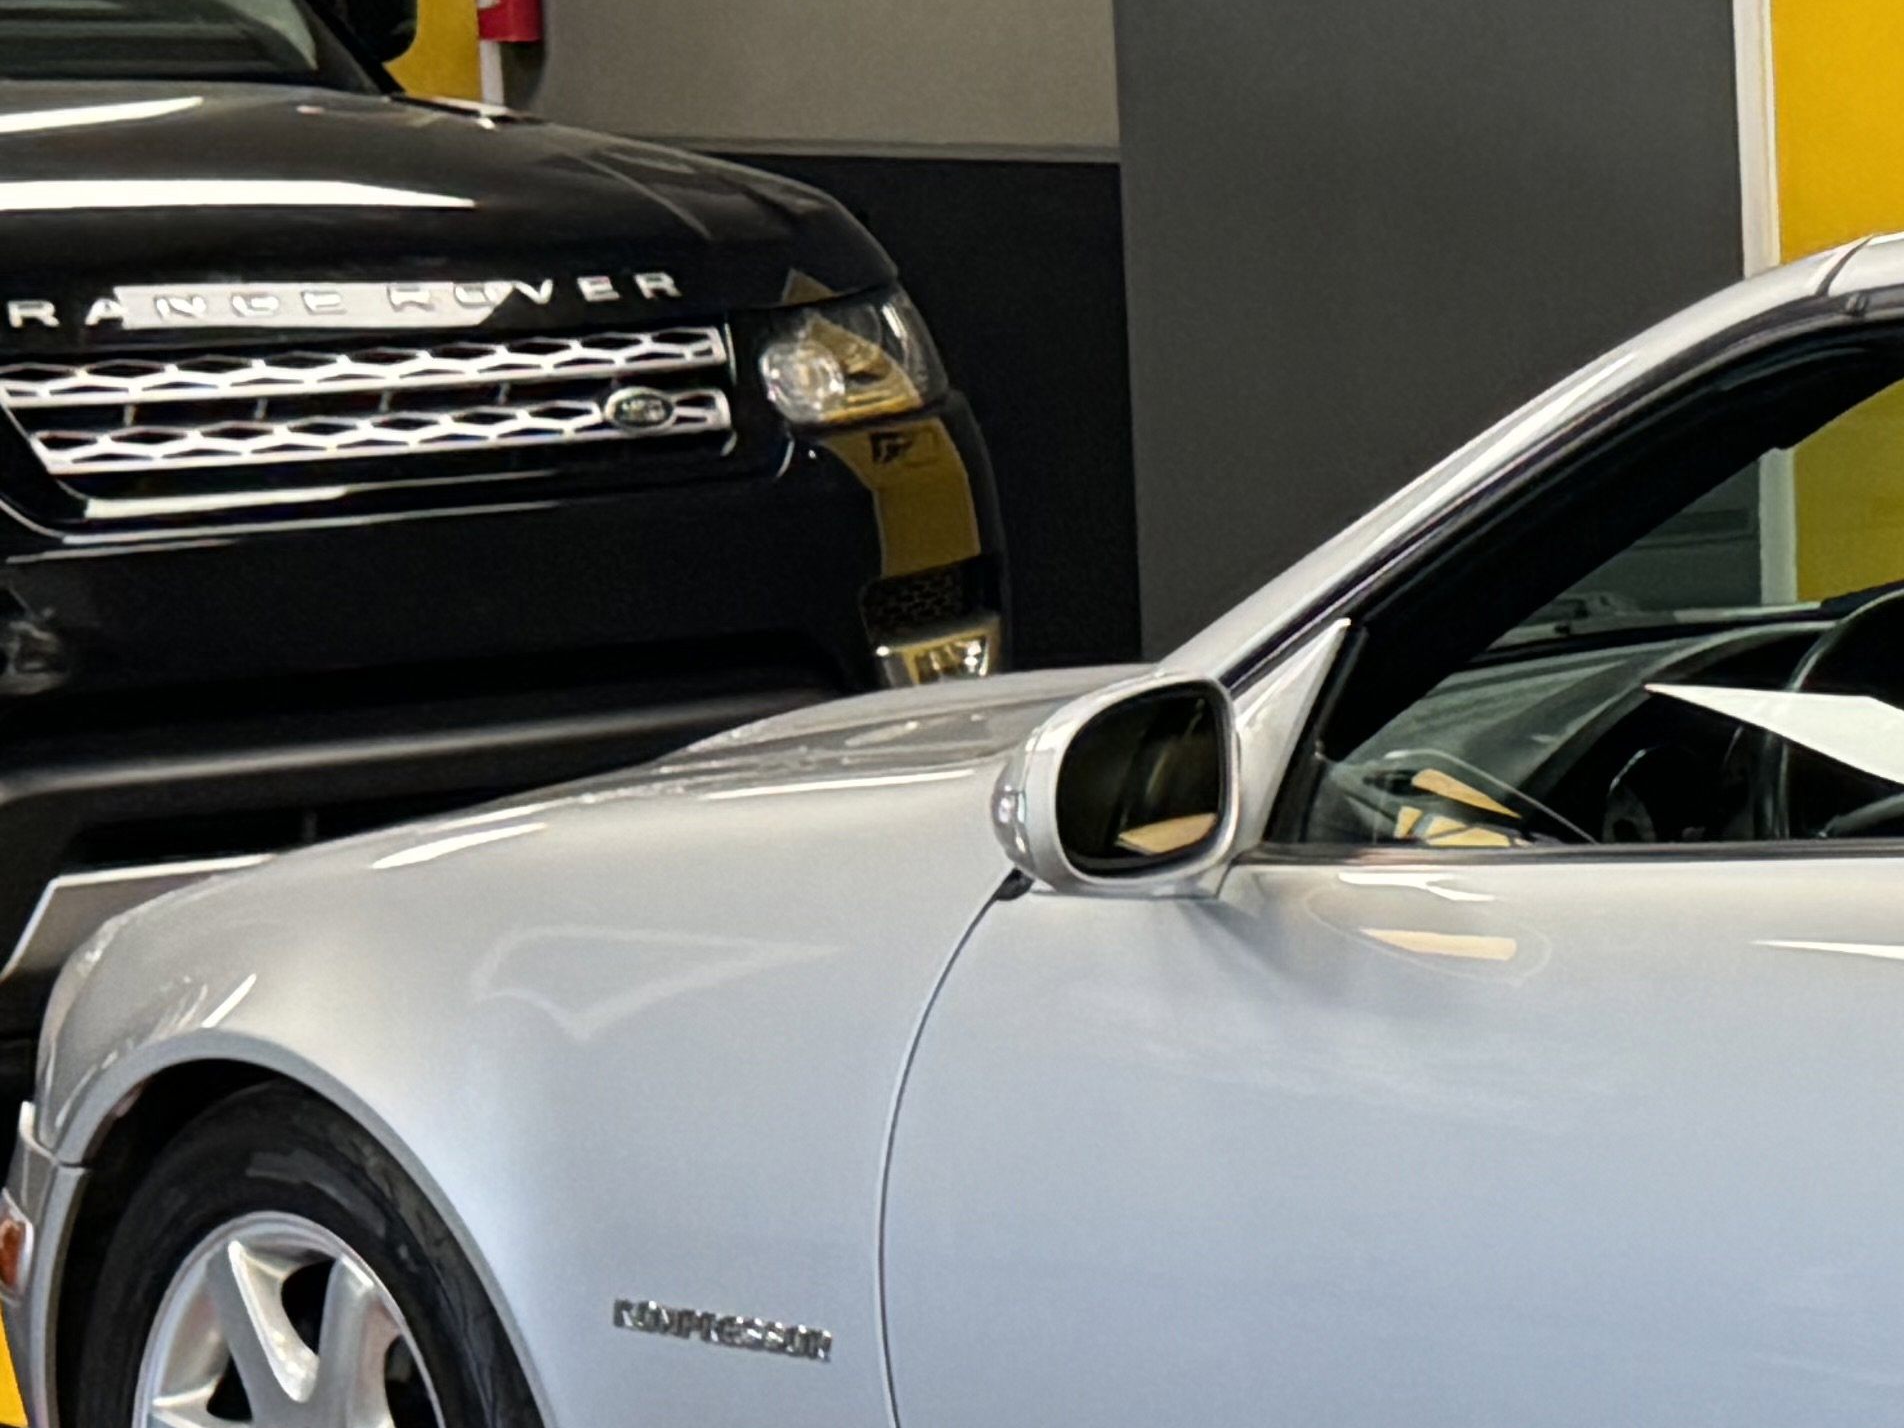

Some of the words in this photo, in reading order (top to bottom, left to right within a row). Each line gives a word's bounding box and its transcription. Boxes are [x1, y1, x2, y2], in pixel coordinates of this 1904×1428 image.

[7, 289, 348, 328] RANGE
[387, 272, 682, 314] ROVER
[612, 1298, 833, 1363] KOMPRESSOR
